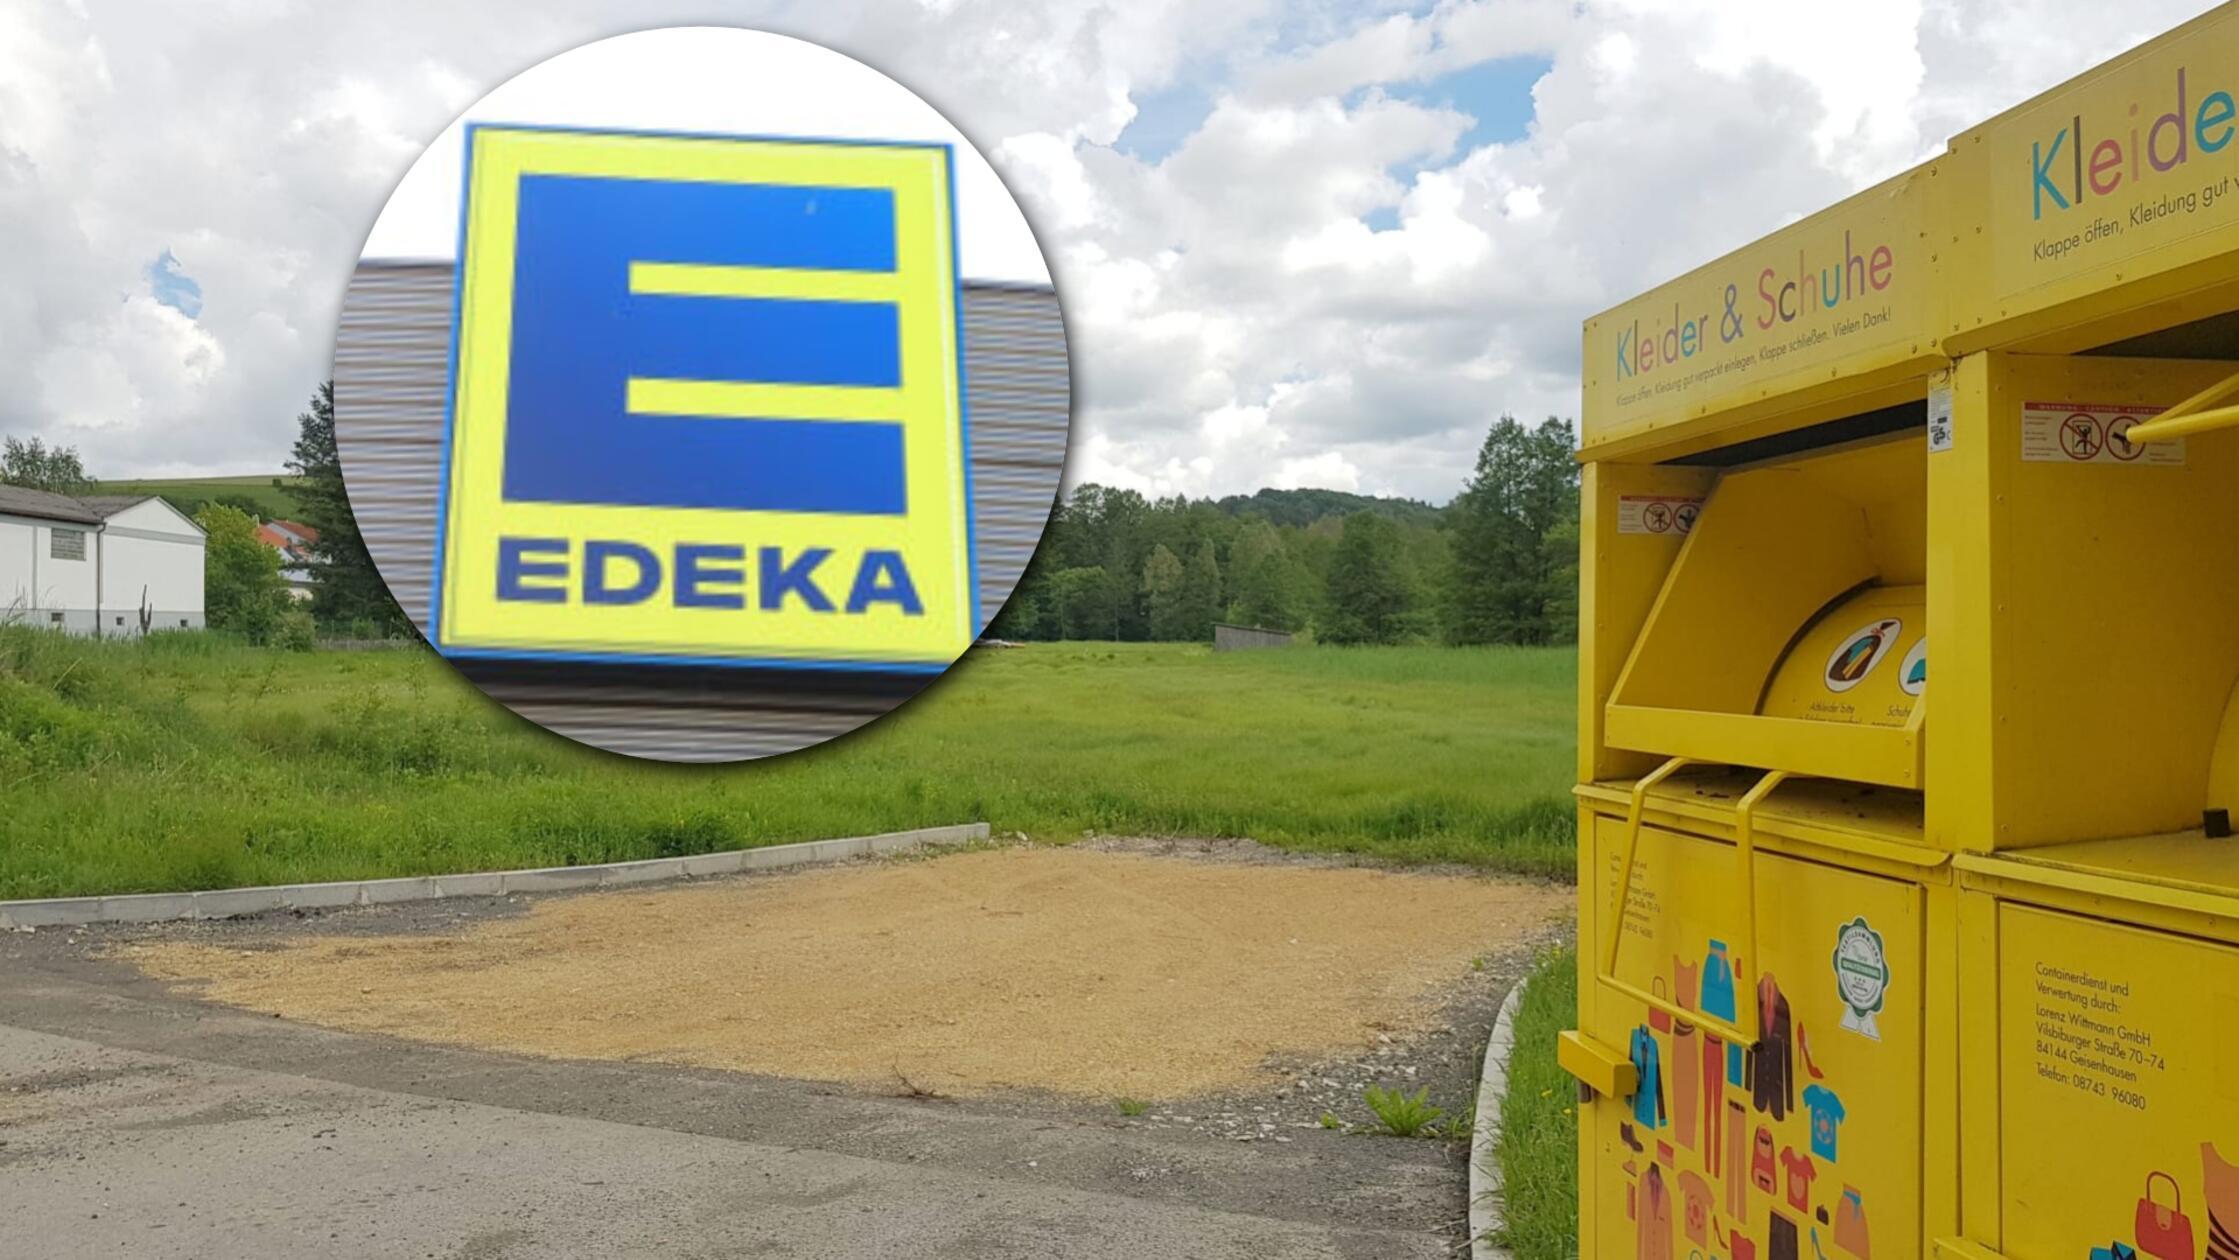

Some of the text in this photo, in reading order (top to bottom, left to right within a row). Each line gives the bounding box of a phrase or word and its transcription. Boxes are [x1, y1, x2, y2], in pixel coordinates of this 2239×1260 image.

[2034, 176, 2229, 262] Klappe öffen, Kleidung gut
[1616, 230, 1893, 382] Kleider & Schuhe
[502, 173, 907, 516] E
[1760, 343, 1787, 362] Klappe
[1833, 317, 1861, 337] Vielen
[1863, 304, 1891, 329] Dank!
[496, 536, 925, 616] EDEKA
[2035, 961, 2129, 997] Containerdienst und
[2036, 981, 2121, 1013] Verwertung durch:
[2036, 1003, 2151, 1047] Lorenz Wittmann GmbH
[2036, 1022, 2092, 1050] Vilsbiburger
[2094, 1037, 2126, 1060] Straße
[2036, 1040, 2137, 1082] 84144 Geisenhausen
[2036, 1062, 2146, 1110] Telefon: 08743 96080
